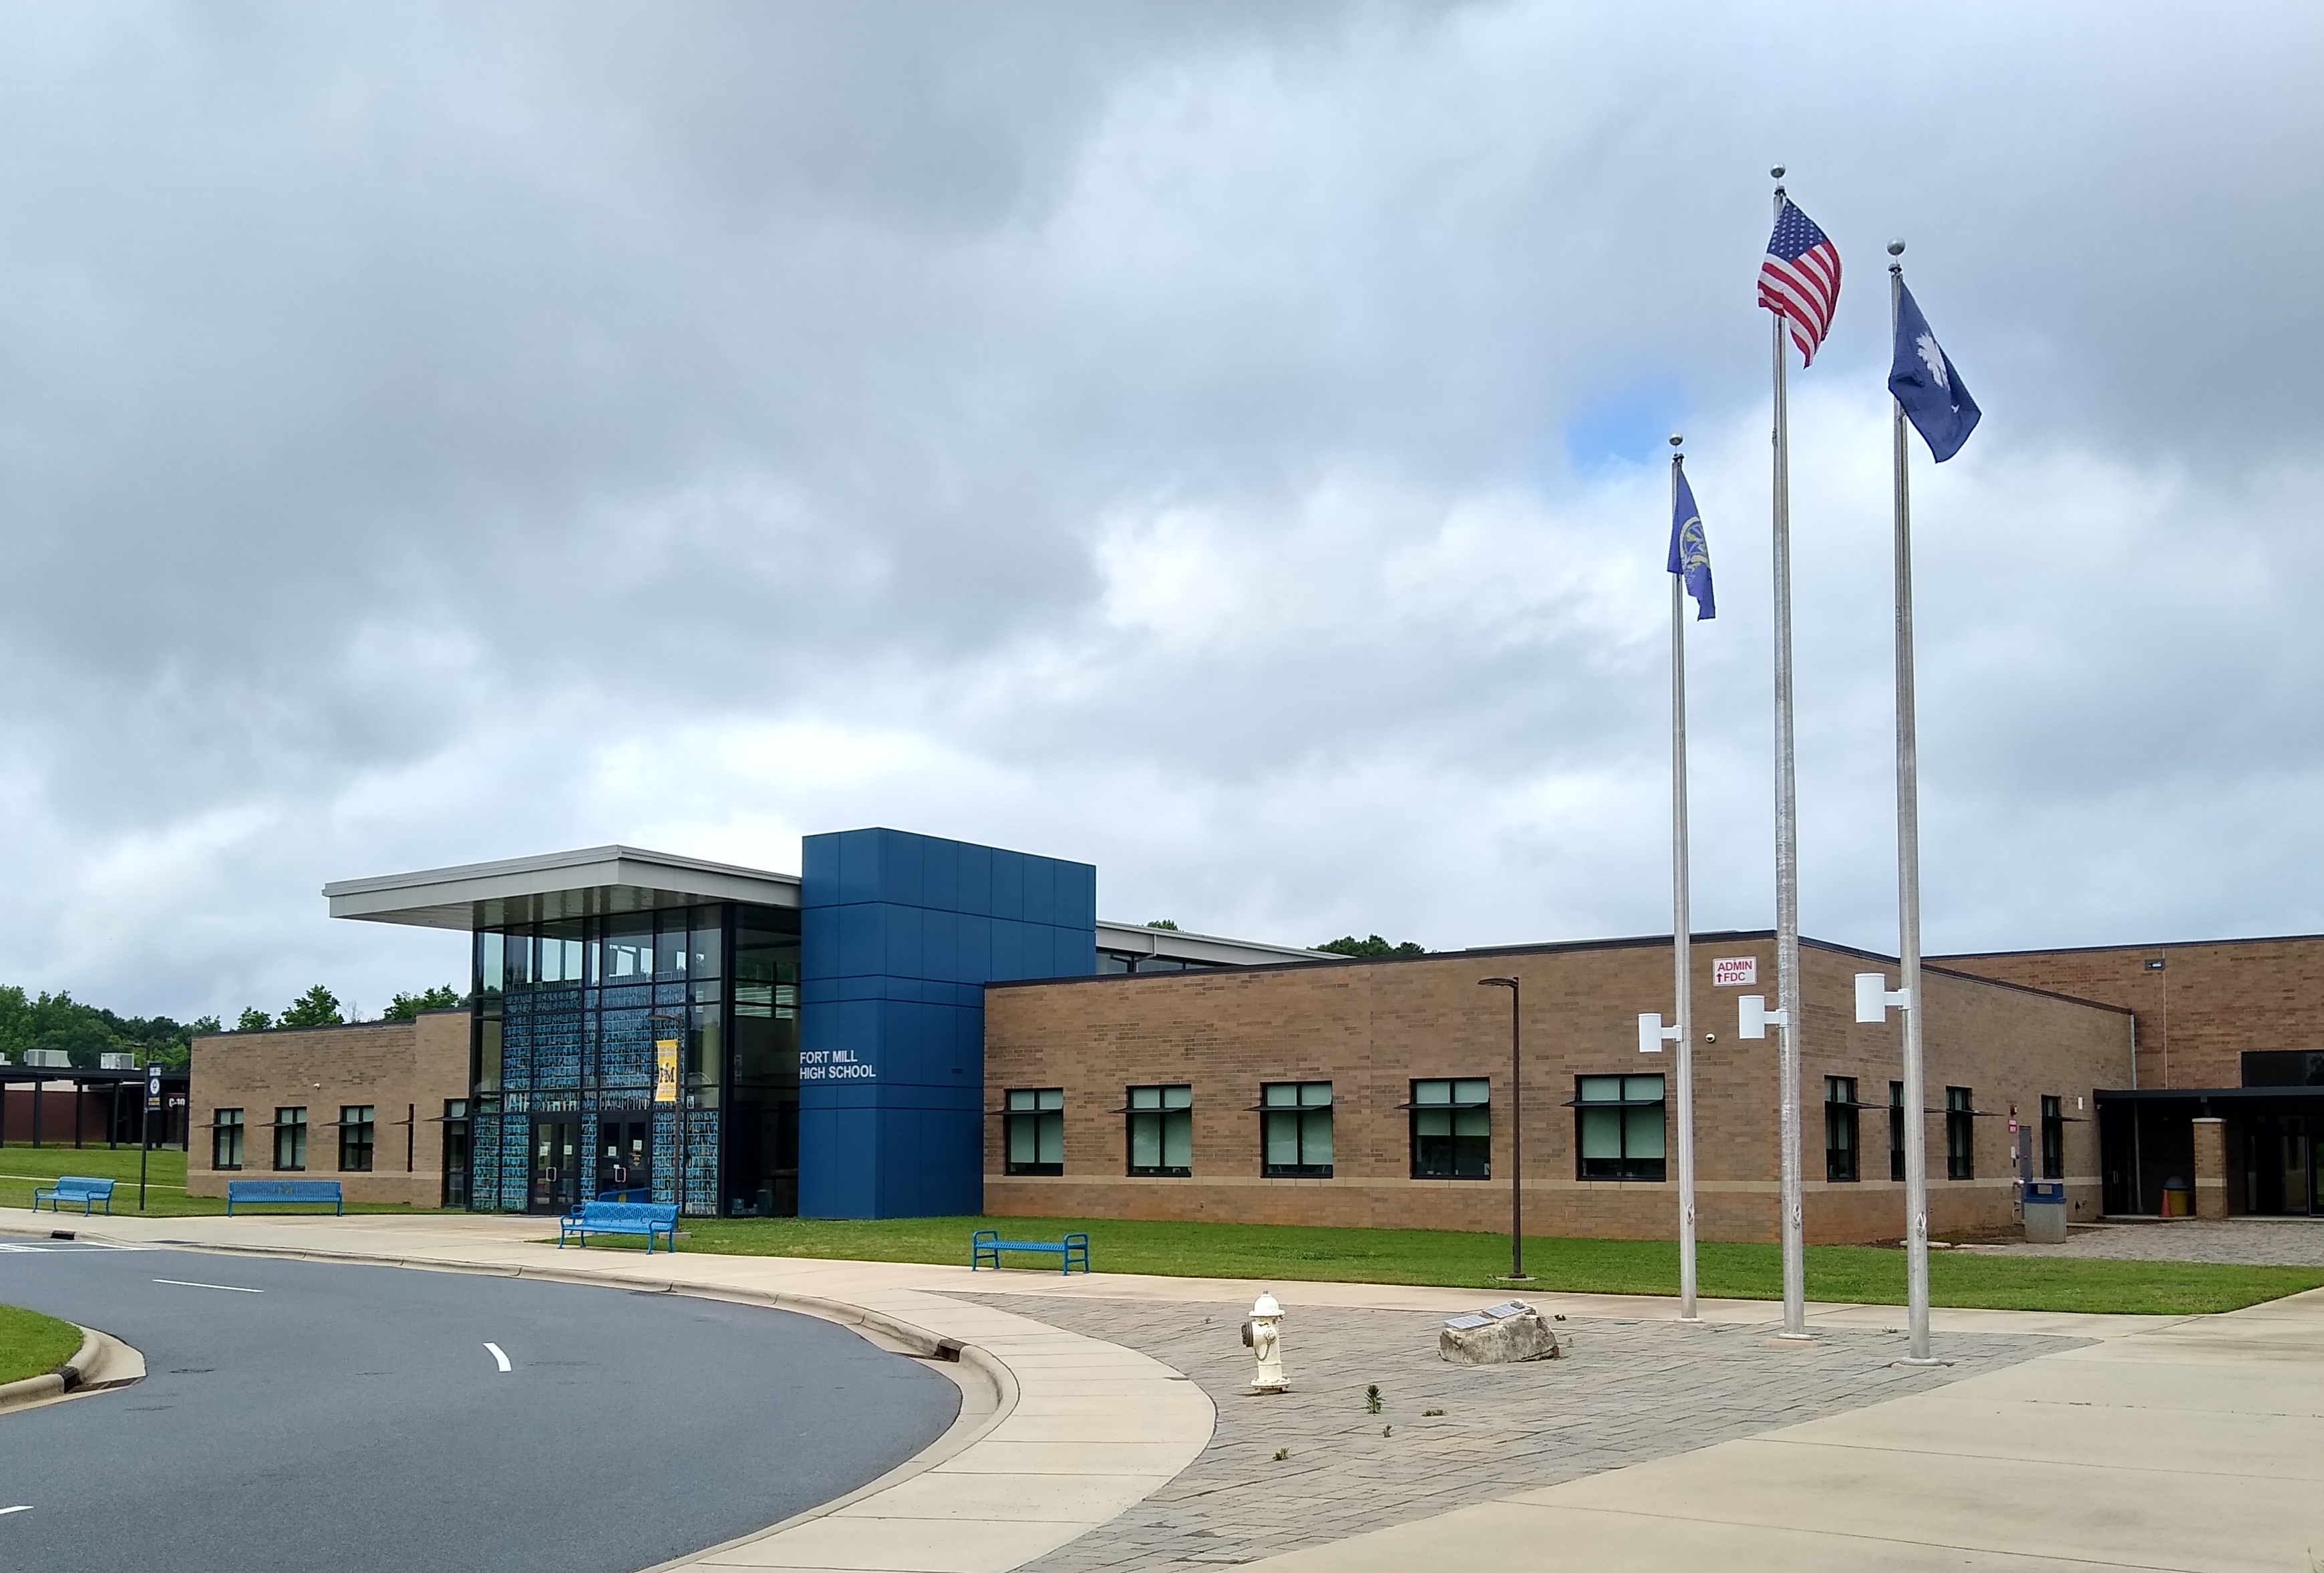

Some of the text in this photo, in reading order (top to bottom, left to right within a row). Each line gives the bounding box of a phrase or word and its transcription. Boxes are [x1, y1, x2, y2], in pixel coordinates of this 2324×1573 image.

[1717, 960, 1752, 971] ADMIN
[1723, 972, 1746, 982] FDC
[800, 1049, 858, 1064] FORT MILL
[799, 1064, 876, 1079] HIGH SCHOOL
